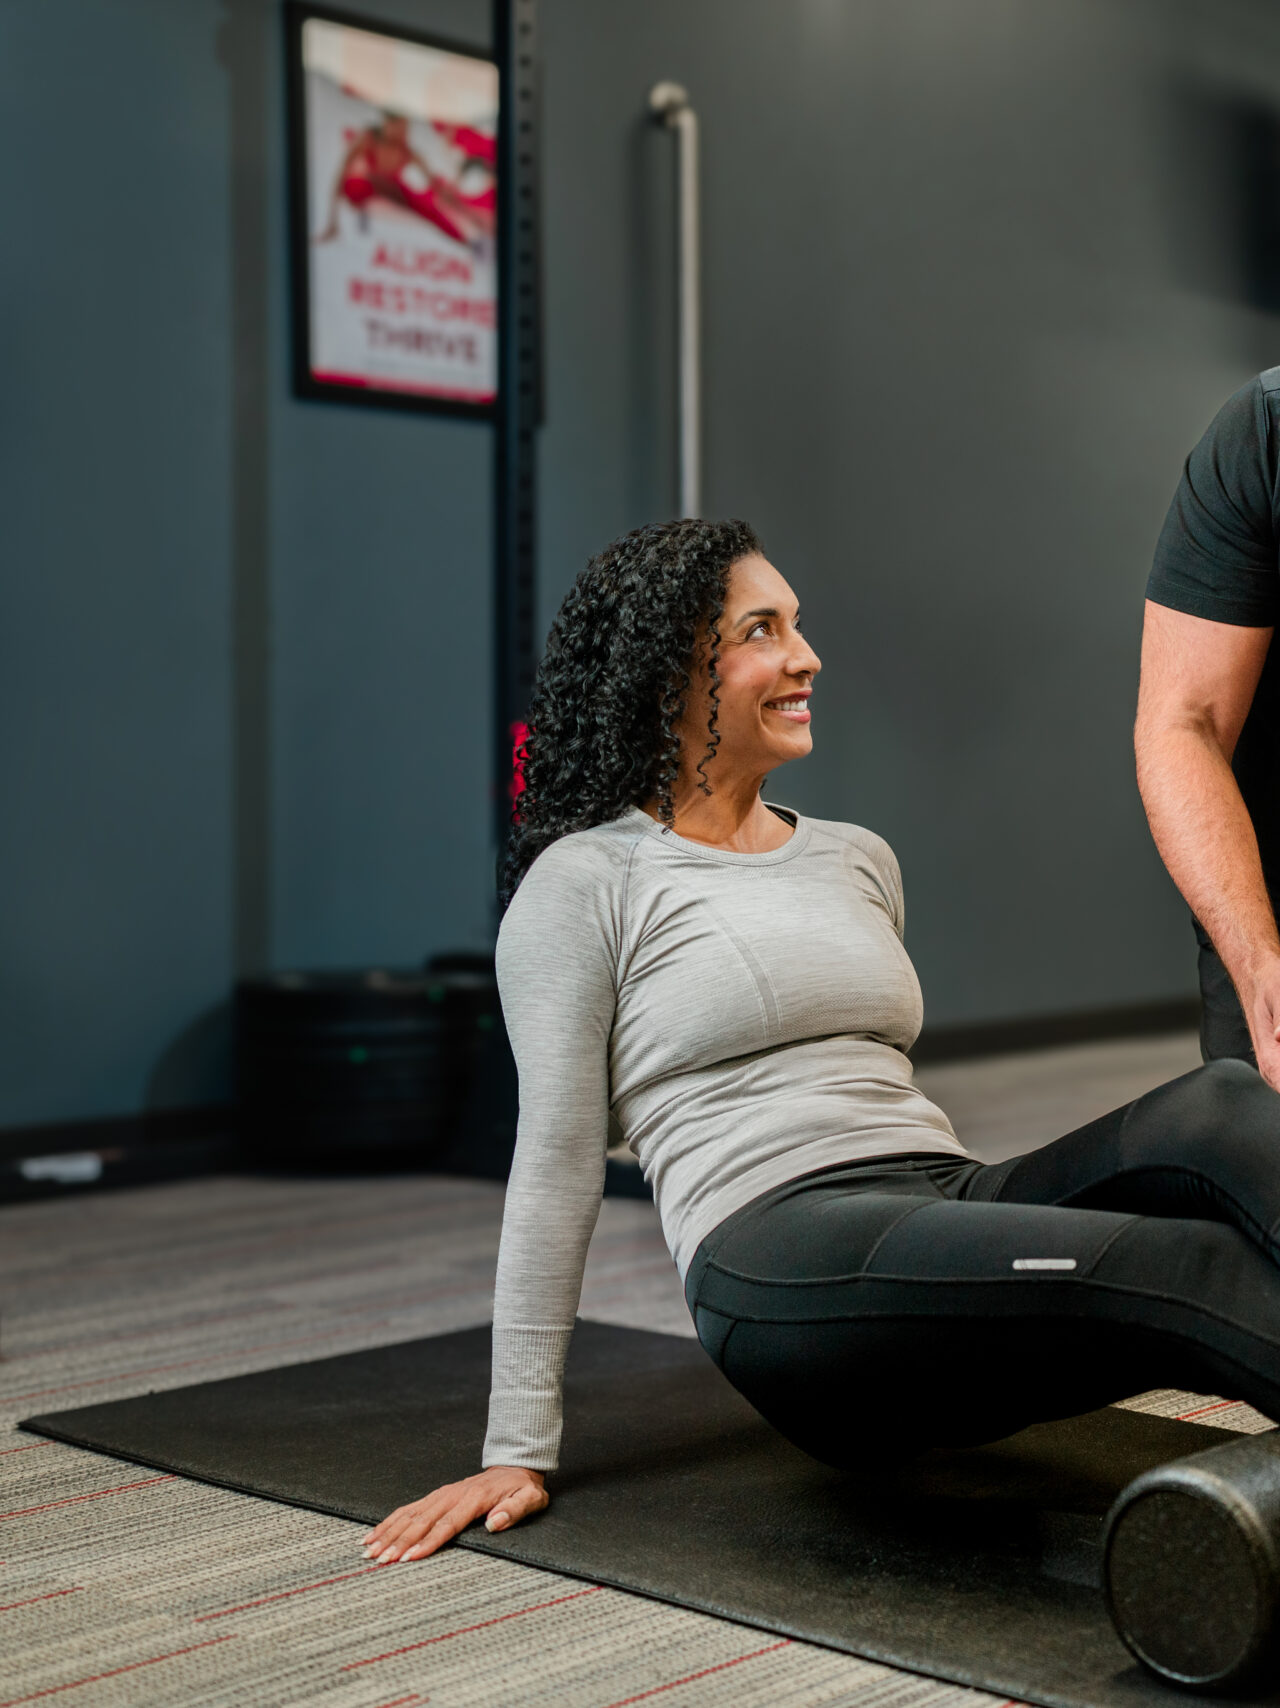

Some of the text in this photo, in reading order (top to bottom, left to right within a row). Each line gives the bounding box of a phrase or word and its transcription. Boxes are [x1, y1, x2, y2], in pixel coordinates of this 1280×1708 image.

[370, 243, 473, 284] ALIGN
[348, 275, 497, 329] RESTORE
[365, 317, 480, 366] THRIVE
